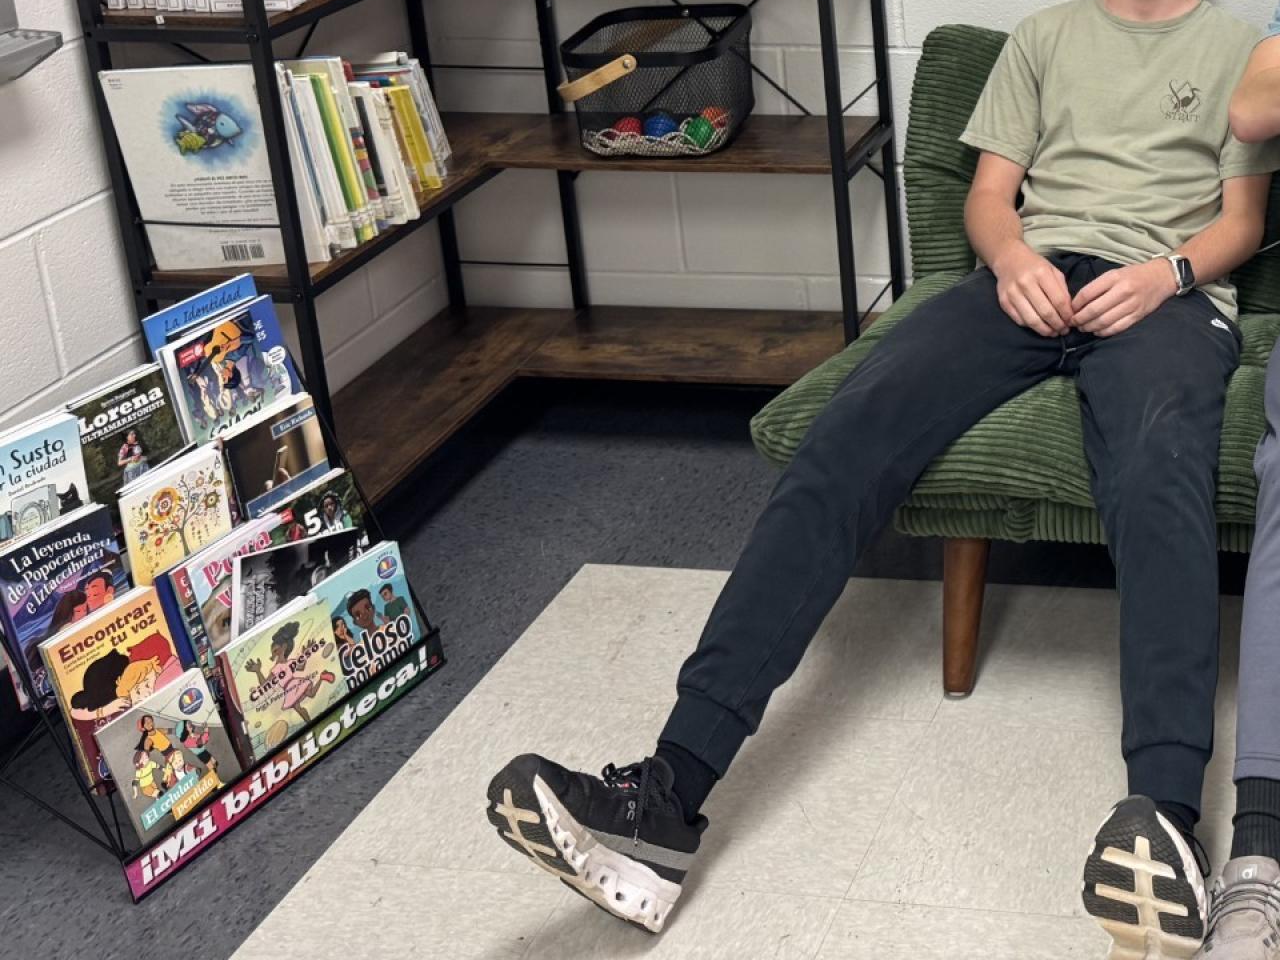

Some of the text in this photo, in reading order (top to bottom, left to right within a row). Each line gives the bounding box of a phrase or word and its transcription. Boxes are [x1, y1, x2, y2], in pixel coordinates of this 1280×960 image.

[163, 286, 243, 333] La Identidad
[78, 385, 165, 437] Lorena
[81, 398, 167, 445] ULTRAMARATONISTA
[8, 450, 68, 487] la ciudad
[10, 439, 65, 471] Susto
[303, 507, 322, 536] 5
[7, 538, 112, 605] de Popocatépetl
[9, 532, 92, 574] La leyenda
[26, 549, 105, 615] e Iztaccíhuatl
[58, 600, 152, 664] Encontrar
[109, 613, 157, 647] tu voz
[338, 614, 413, 677] Celoso
[249, 667, 286, 703] Cinco
[287, 637, 327, 673] pesos
[346, 661, 374, 690] por
[373, 633, 416, 672] amor
[221, 646, 428, 822] biblioteca!
[143, 777, 196, 827] El celular
[175, 776, 215, 817] perdido
